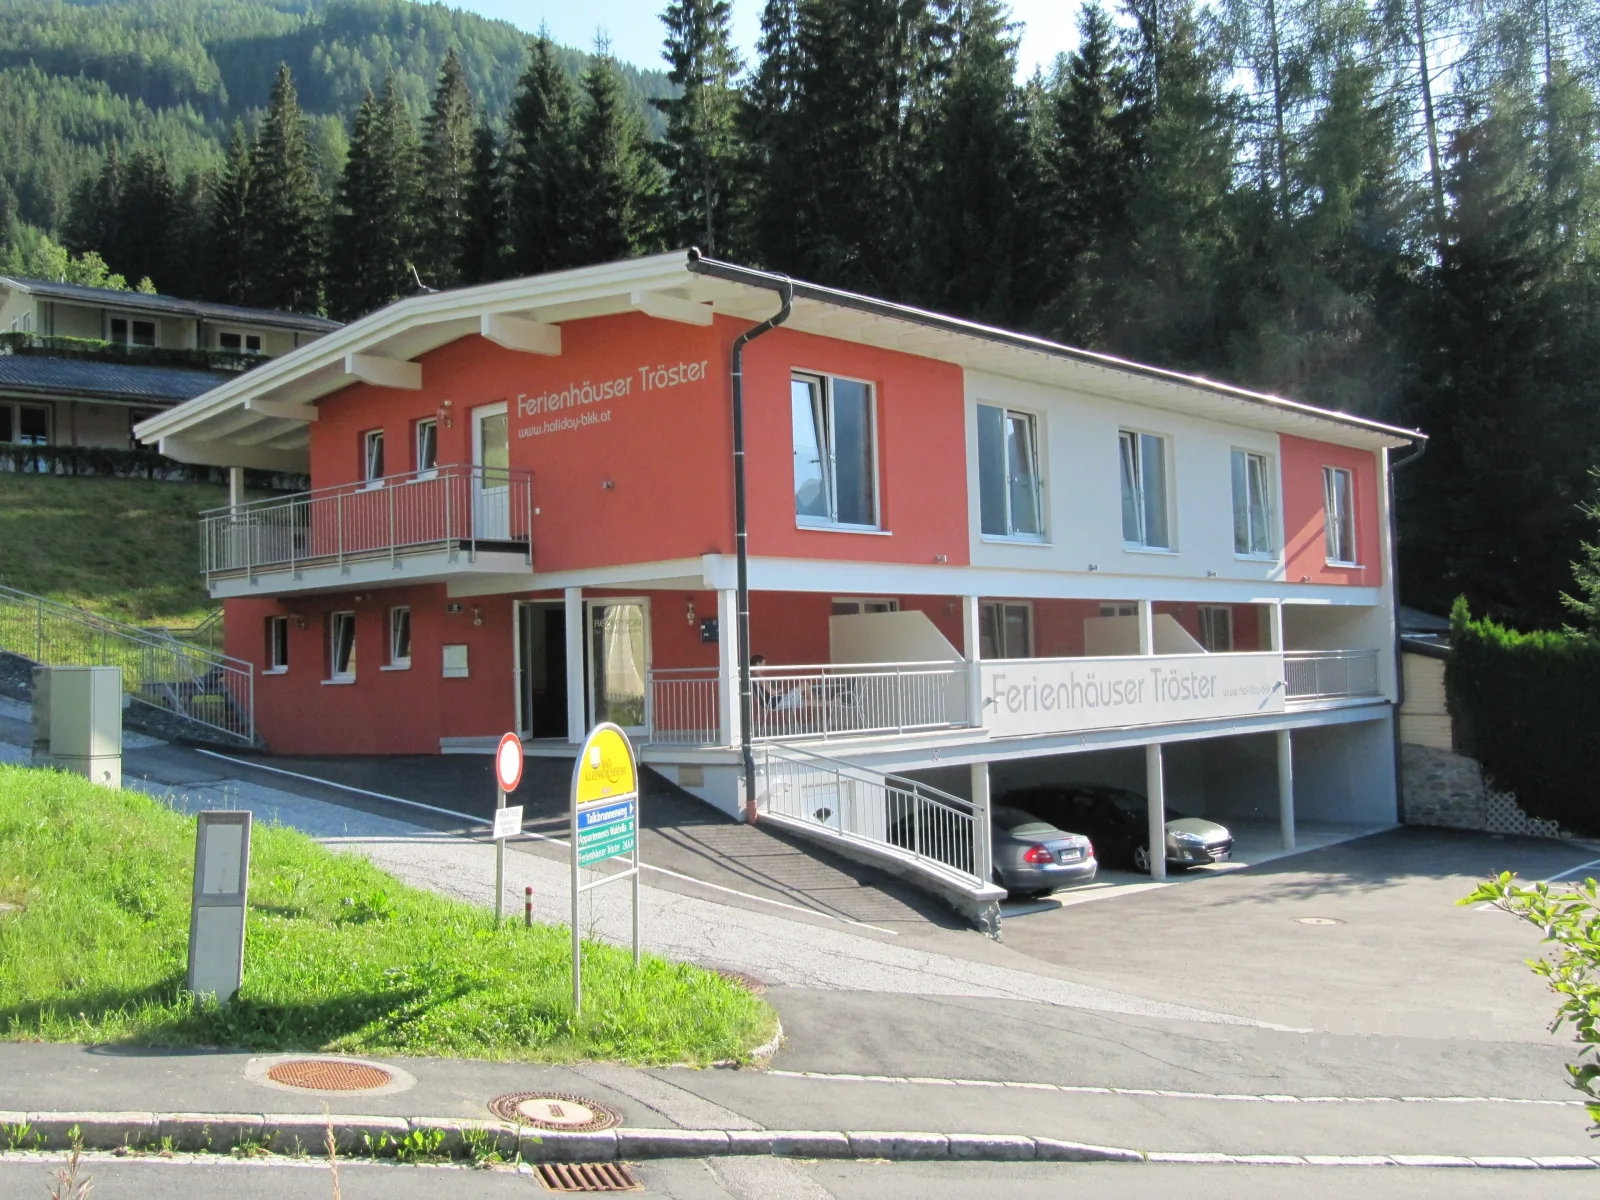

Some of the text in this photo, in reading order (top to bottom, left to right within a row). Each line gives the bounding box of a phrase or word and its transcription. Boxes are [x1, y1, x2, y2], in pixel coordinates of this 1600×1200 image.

[517, 360, 708, 418] Ferienhäuser Tröster
[518, 409, 611, 438] www.holiday-bkk.at
[992, 671, 1145, 714] Ferienhäuser
[1150, 667, 1217, 702] Tröster
